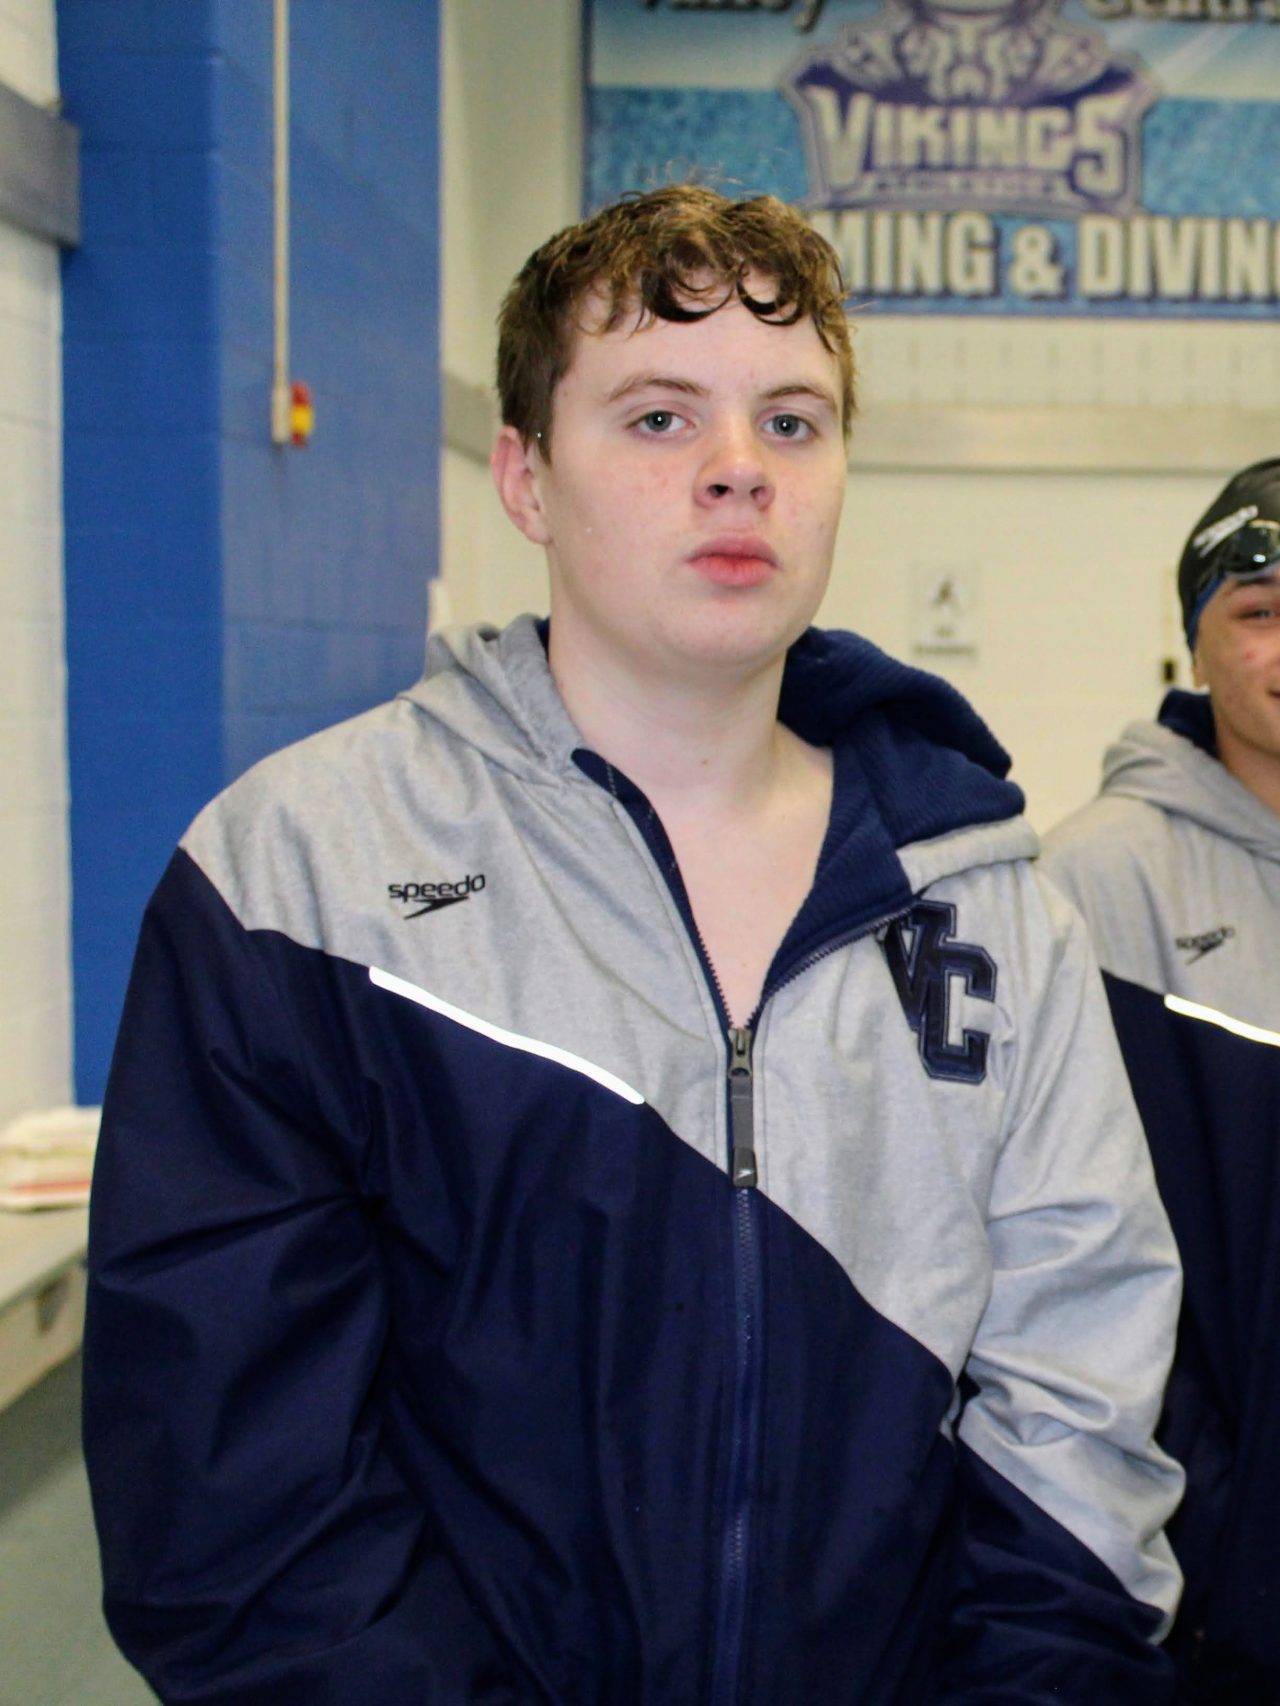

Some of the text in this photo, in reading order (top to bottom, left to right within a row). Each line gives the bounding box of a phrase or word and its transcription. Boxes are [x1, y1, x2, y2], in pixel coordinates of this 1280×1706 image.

[800, 85, 1133, 197] VIKINGS
[1010, 224, 1063, 298] &
[387, 874, 486, 903] speedo
